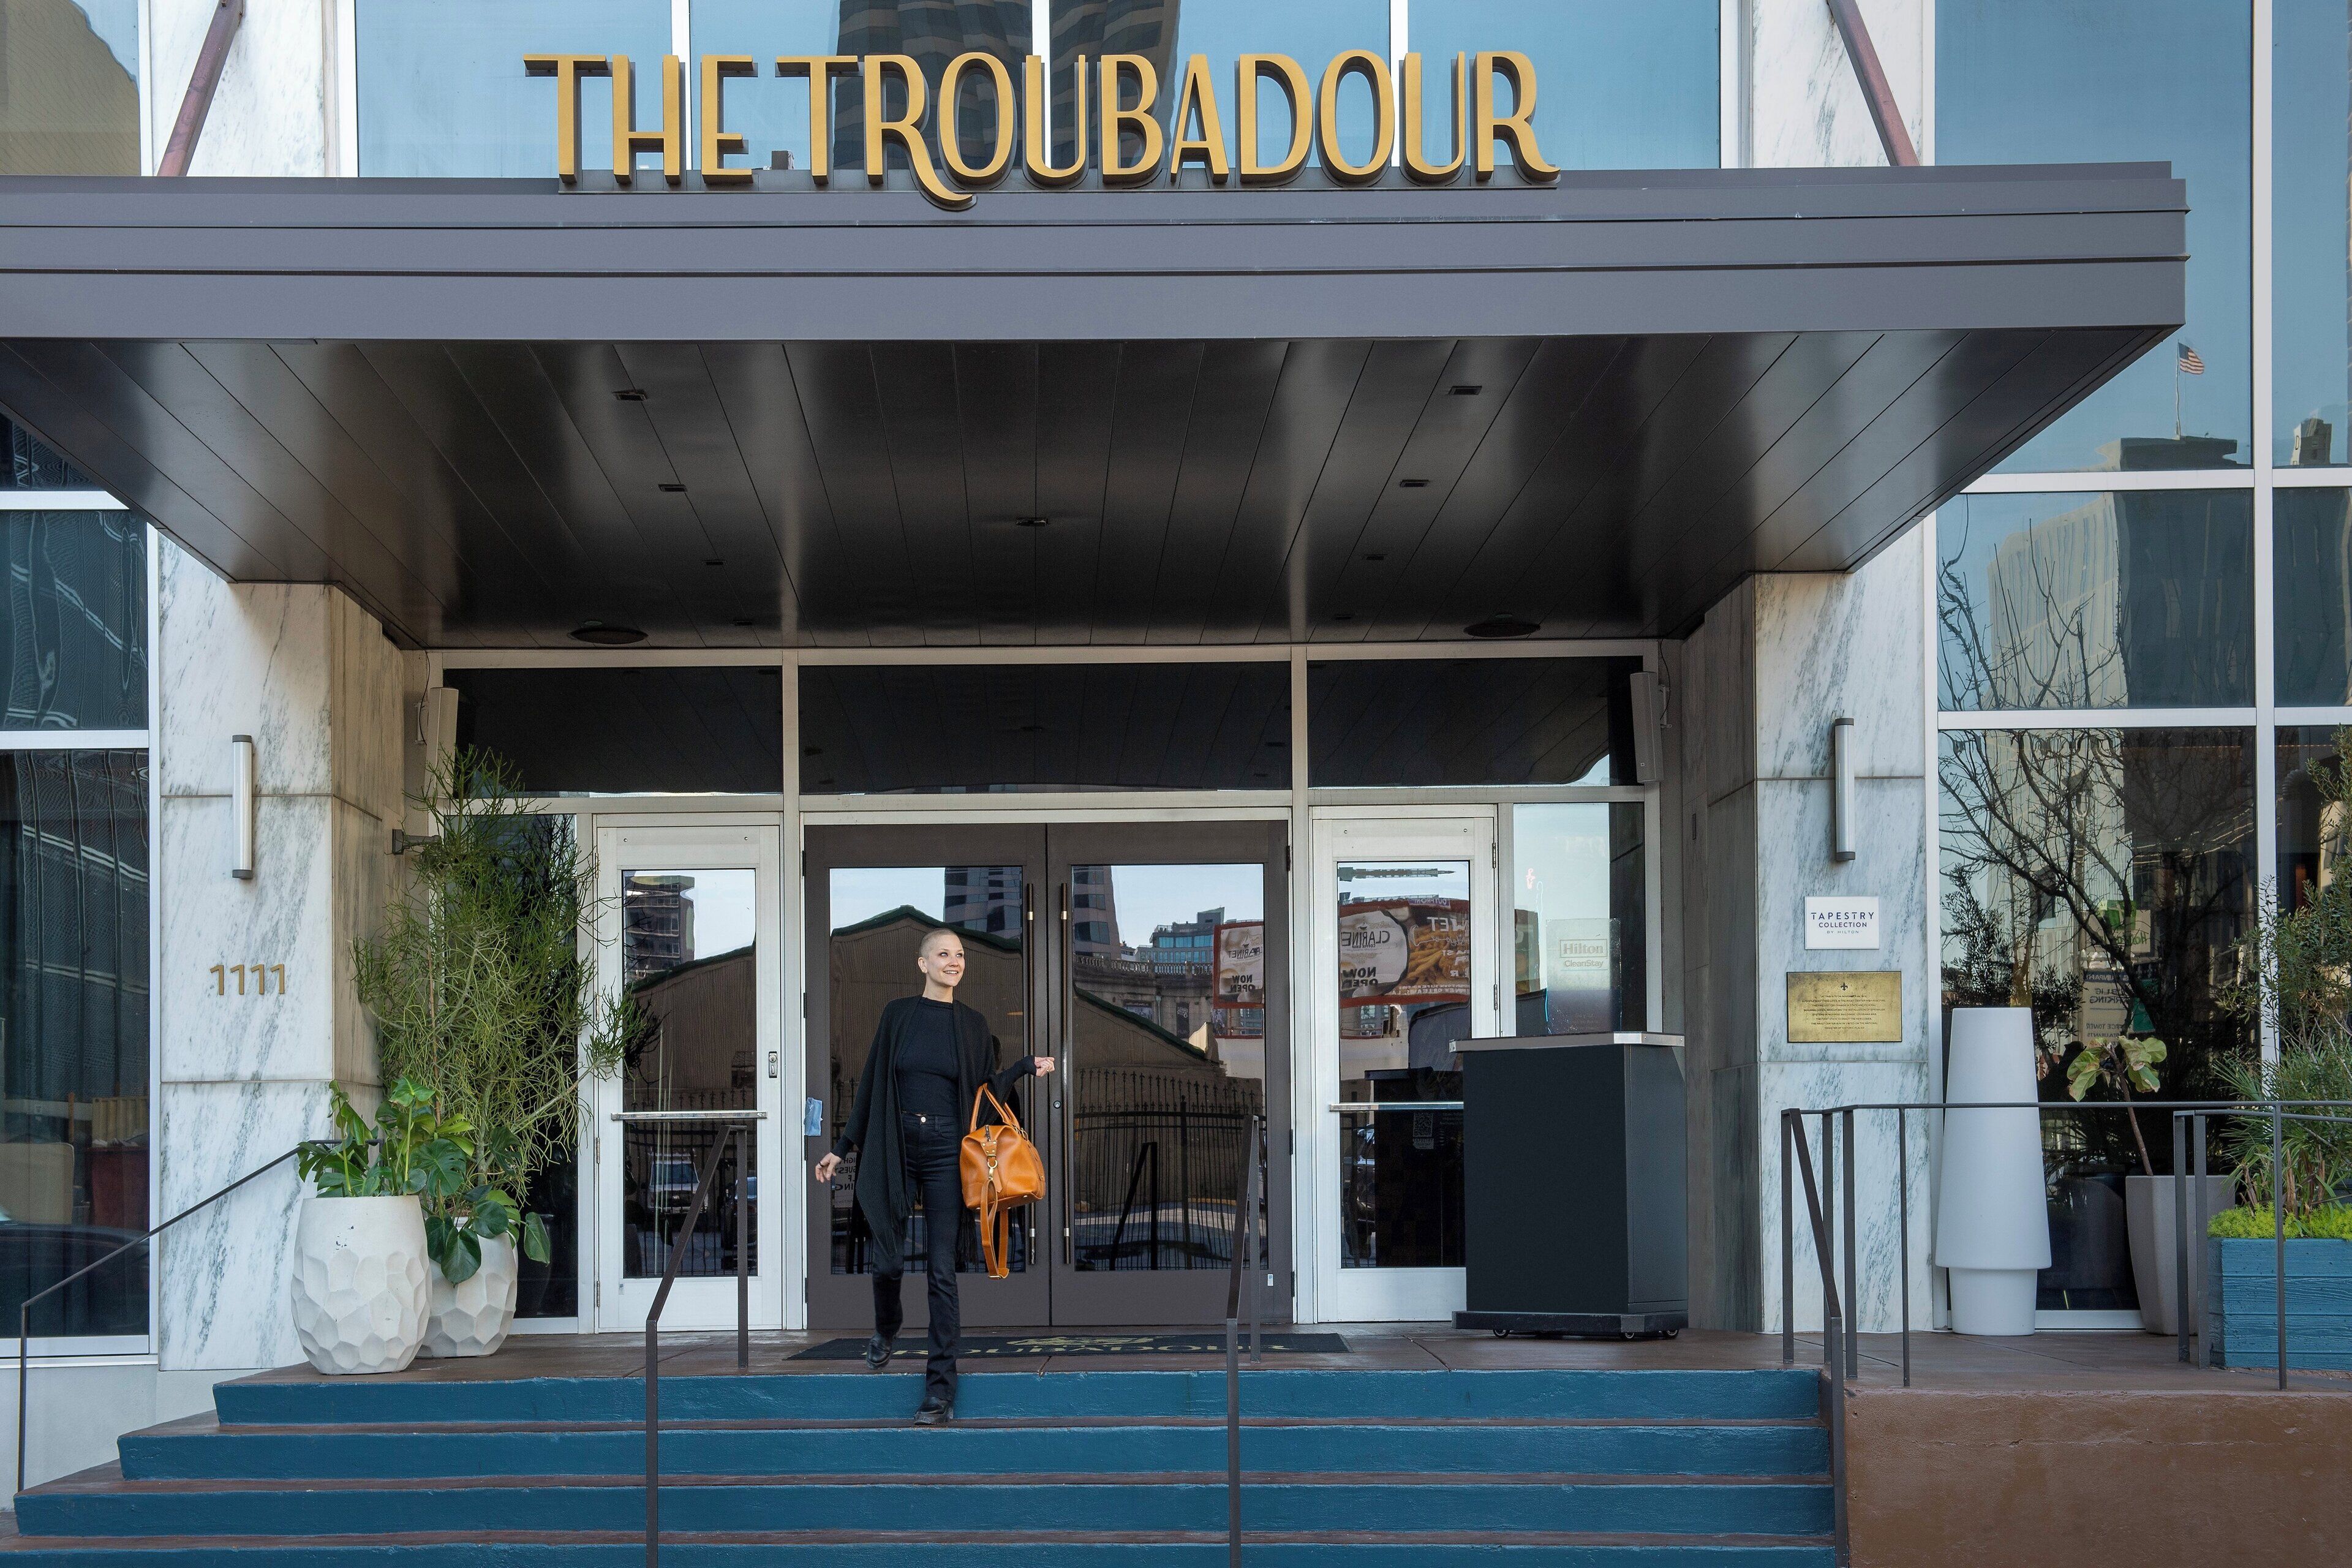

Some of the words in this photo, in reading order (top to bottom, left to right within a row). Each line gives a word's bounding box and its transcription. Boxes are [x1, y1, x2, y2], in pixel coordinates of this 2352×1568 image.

[522, 53, 756, 186] THE
[775, 49, 1561, 211] TROUBADOUR
[1811, 911, 1874, 920] TAPESTRY
[1563, 943, 1604, 955] Hilton
[1564, 960, 1604, 968] CleanStay
[209, 963, 285, 995] 1111
